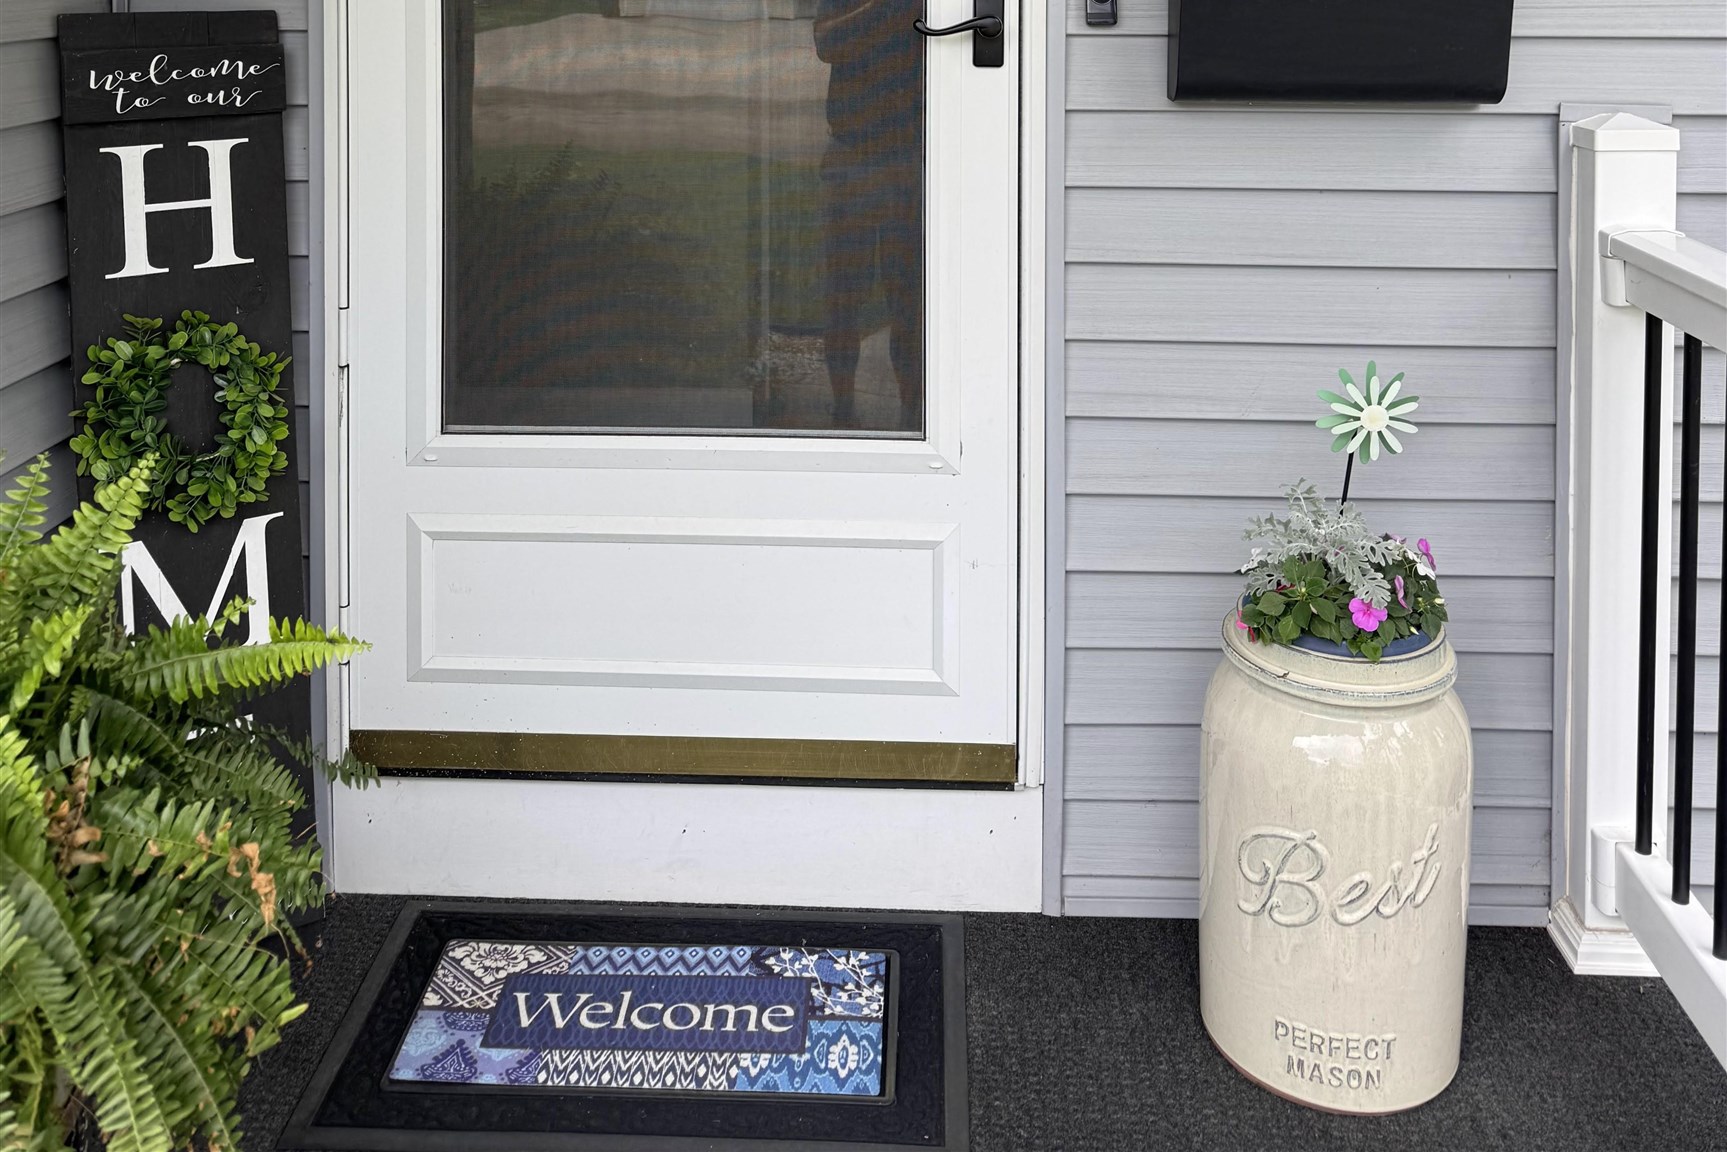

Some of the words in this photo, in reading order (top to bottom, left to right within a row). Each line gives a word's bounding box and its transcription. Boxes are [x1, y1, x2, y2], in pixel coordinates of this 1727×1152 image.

[89, 54, 280, 90] welcome
[112, 88, 166, 114] to
[187, 87, 262, 107] our
[1237, 822, 1441, 927] Best
[513, 991, 795, 1032] Welcome
[1274, 1017, 1397, 1061] PERFECT
[1286, 1054, 1382, 1090] MASON
